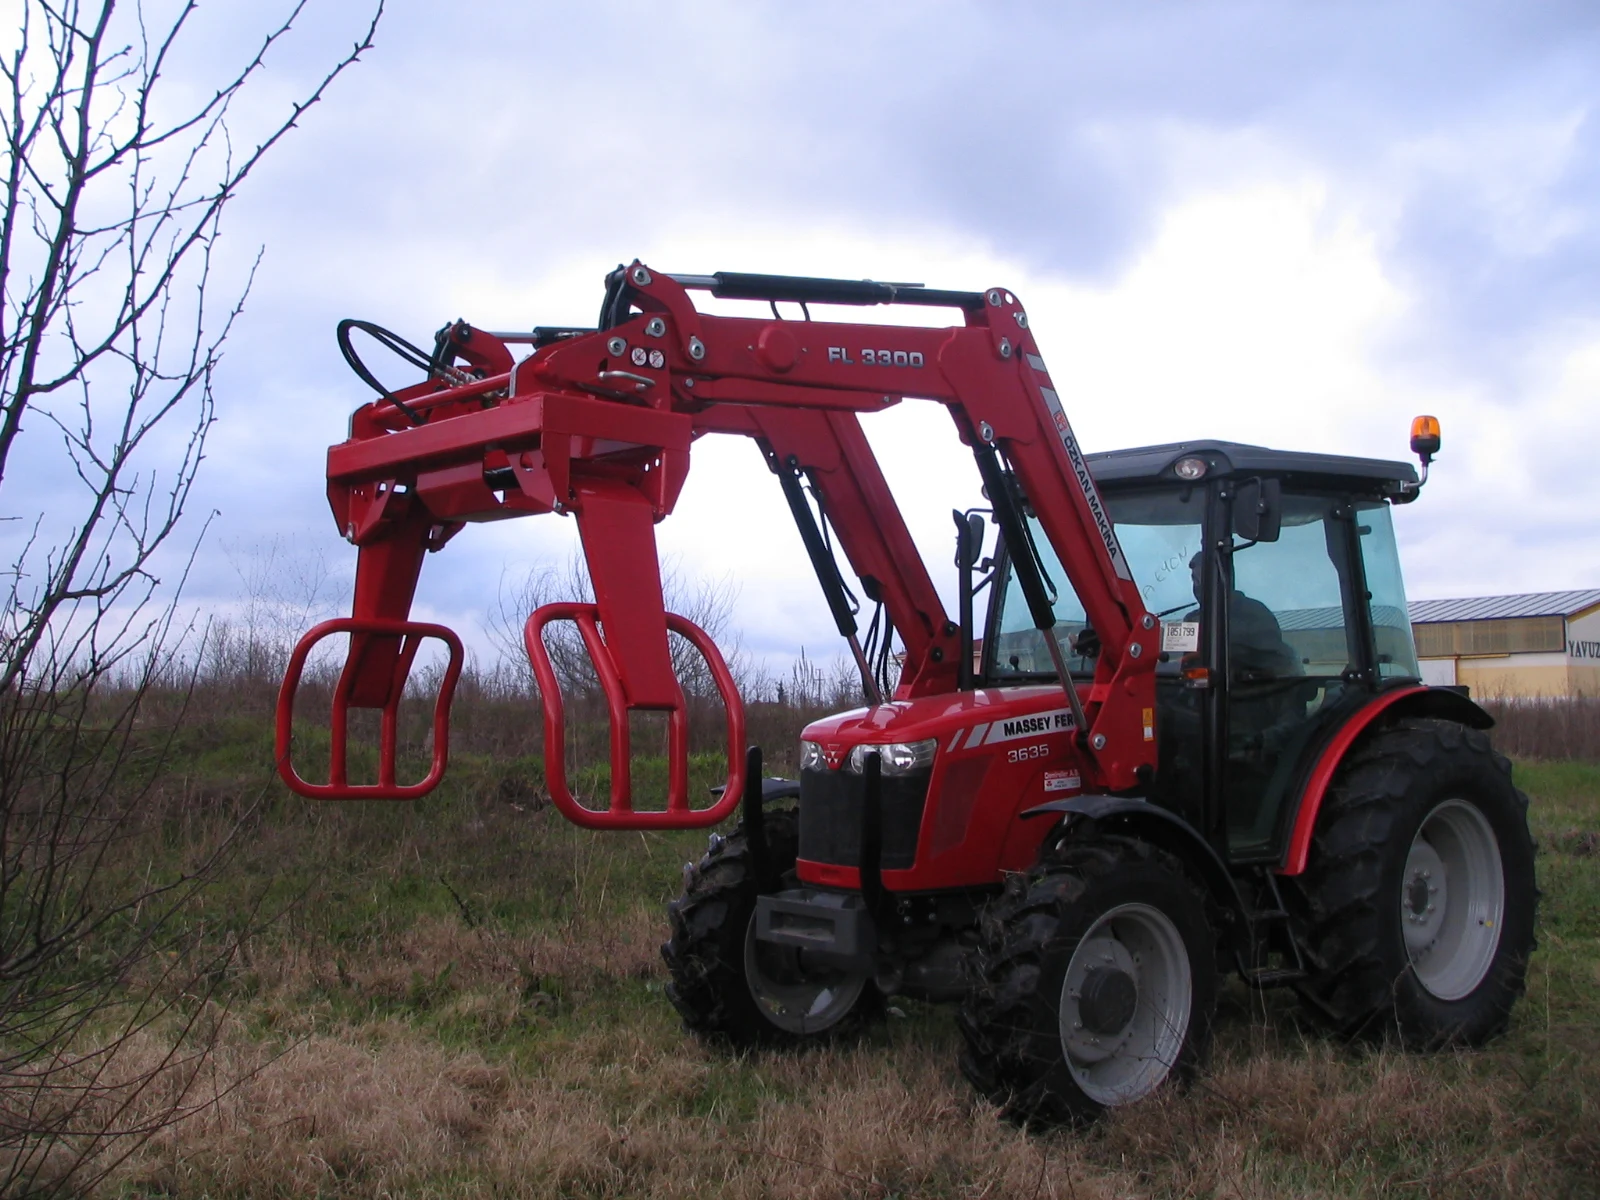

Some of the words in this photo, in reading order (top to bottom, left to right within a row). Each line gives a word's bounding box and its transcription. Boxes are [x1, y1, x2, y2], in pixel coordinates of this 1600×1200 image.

[828, 347, 854, 365] FL
[861, 349, 924, 368] 3300
[1064, 435, 1091, 493] ÖZKAN
[1568, 640, 1600, 659] YAVUZ
[1003, 716, 1051, 737] MASSEY
[1007, 744, 1049, 763] 3635
